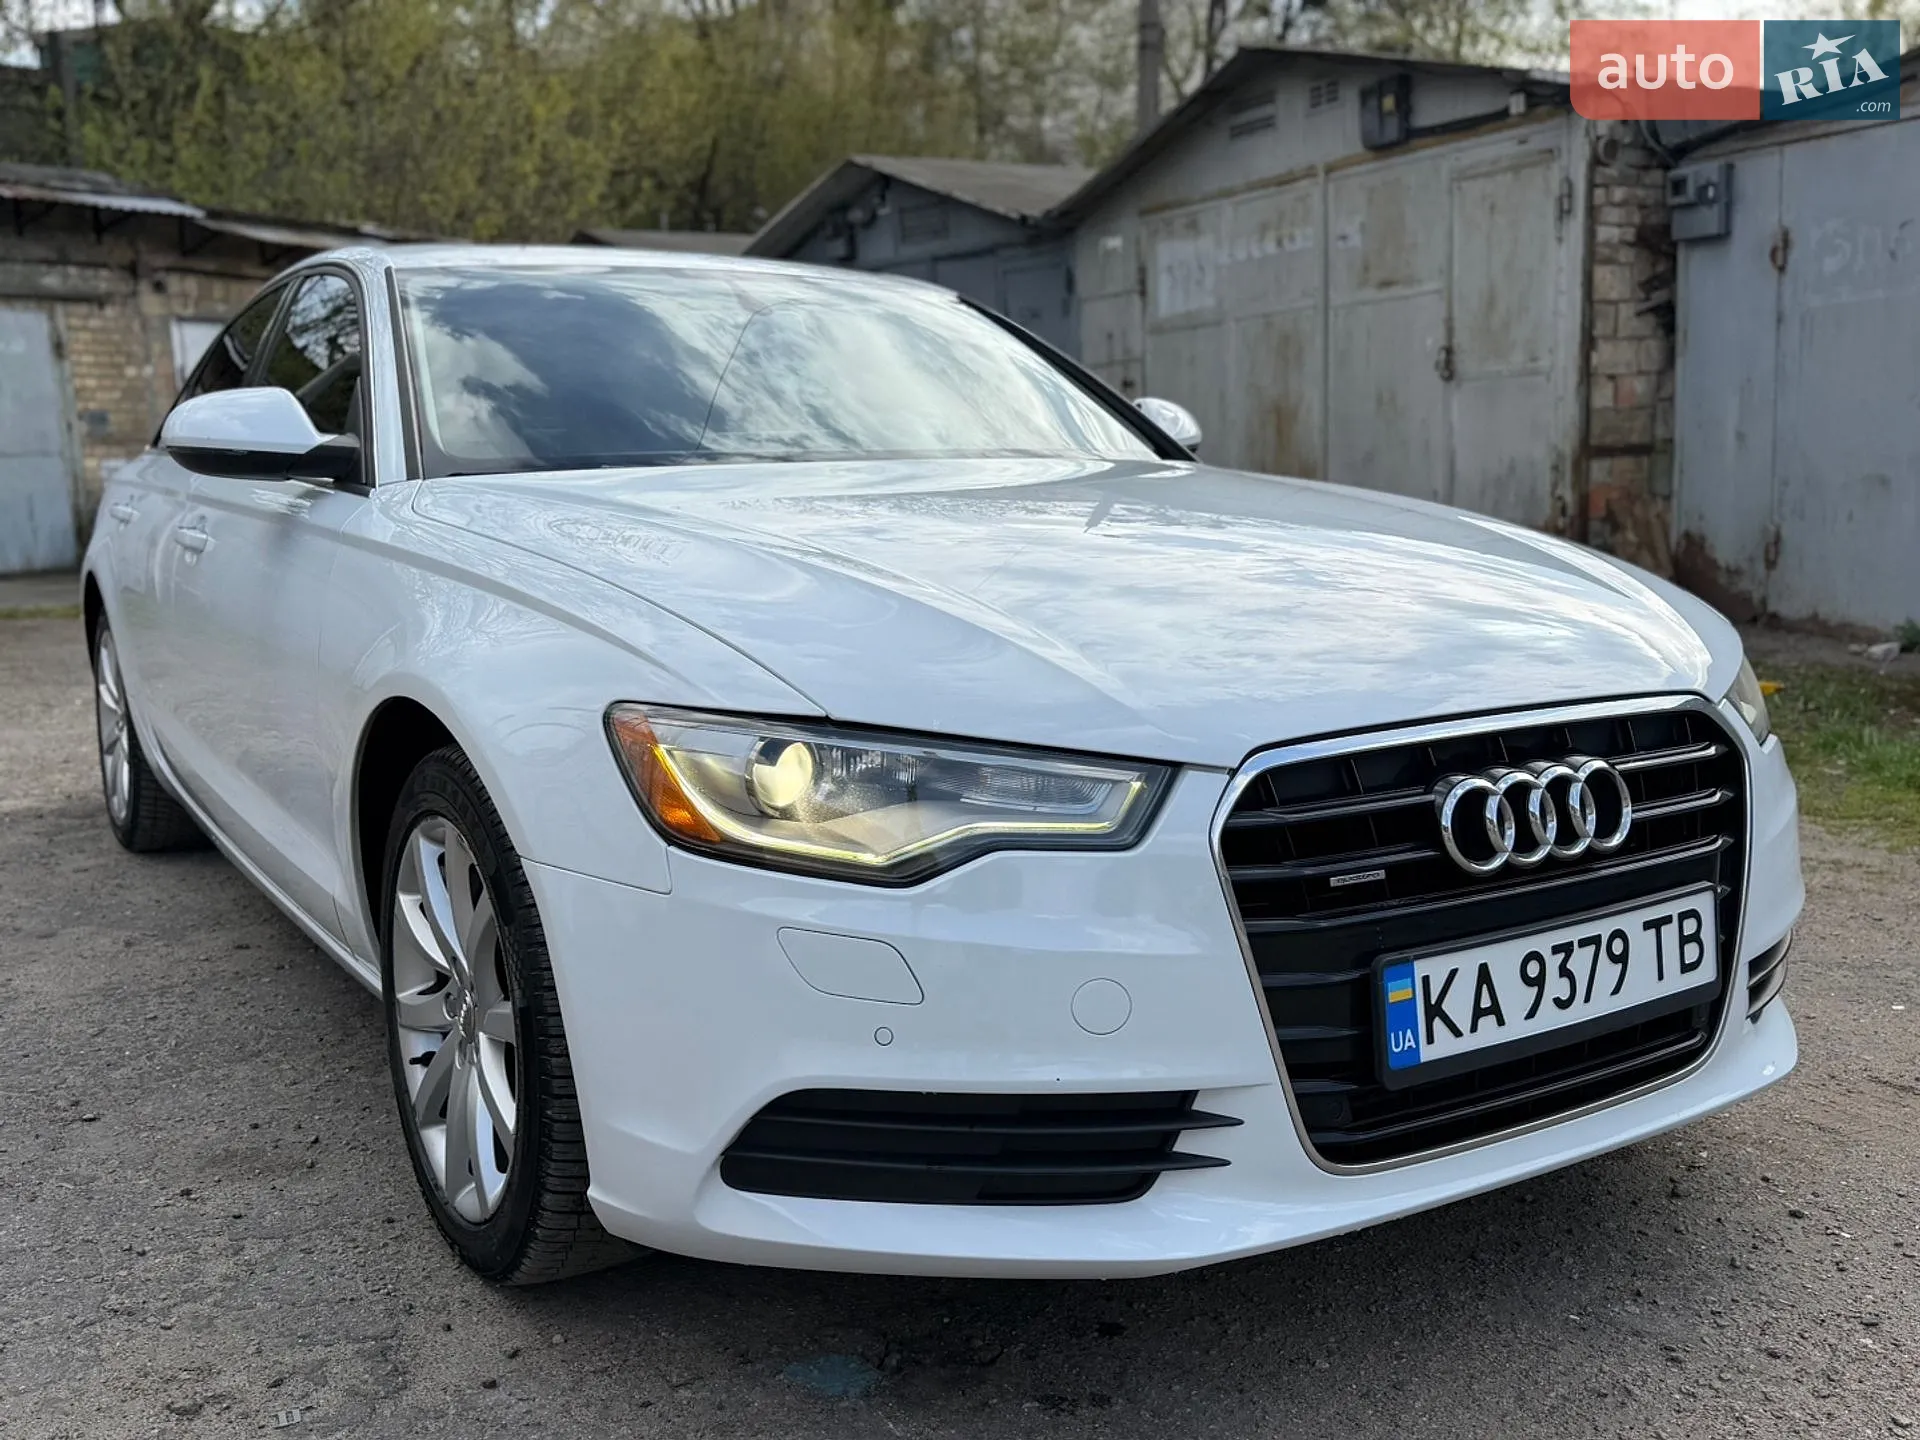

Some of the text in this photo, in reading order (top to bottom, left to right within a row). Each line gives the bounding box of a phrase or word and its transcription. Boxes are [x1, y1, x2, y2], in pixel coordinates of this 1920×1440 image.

[1421, 908, 1705, 1046] KA 9379 TB
[1391, 1028, 1416, 1053] UA
